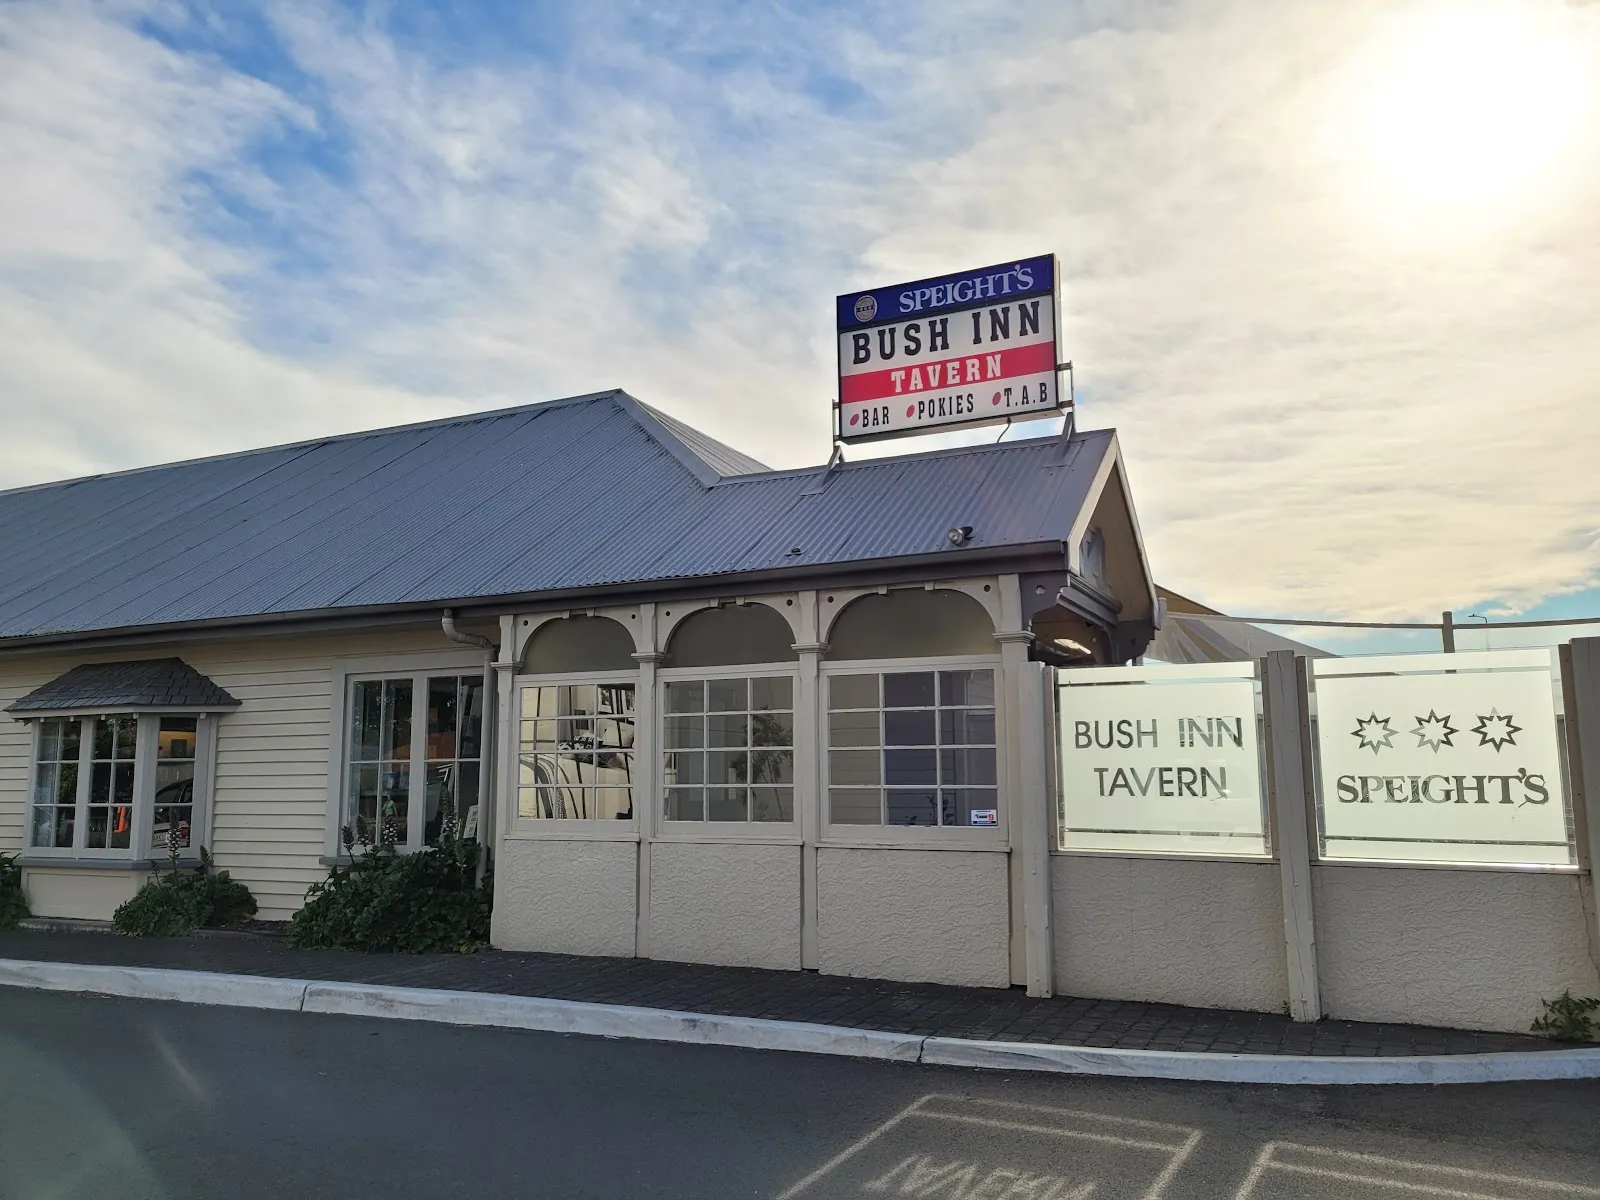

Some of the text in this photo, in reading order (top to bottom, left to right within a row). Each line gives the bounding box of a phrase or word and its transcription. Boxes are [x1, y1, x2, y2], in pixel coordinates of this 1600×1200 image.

[899, 264, 1034, 313] SPEIGHT'S
[852, 301, 1040, 365] BUSH INN
[891, 354, 1002, 393] TAVERN
[862, 382, 1048, 428] BAR POKIES T.A.B
[1075, 717, 1243, 749] BUSH INN
[1094, 766, 1228, 799] TAVERN
[1336, 767, 1550, 806] SPEIGHT'S
